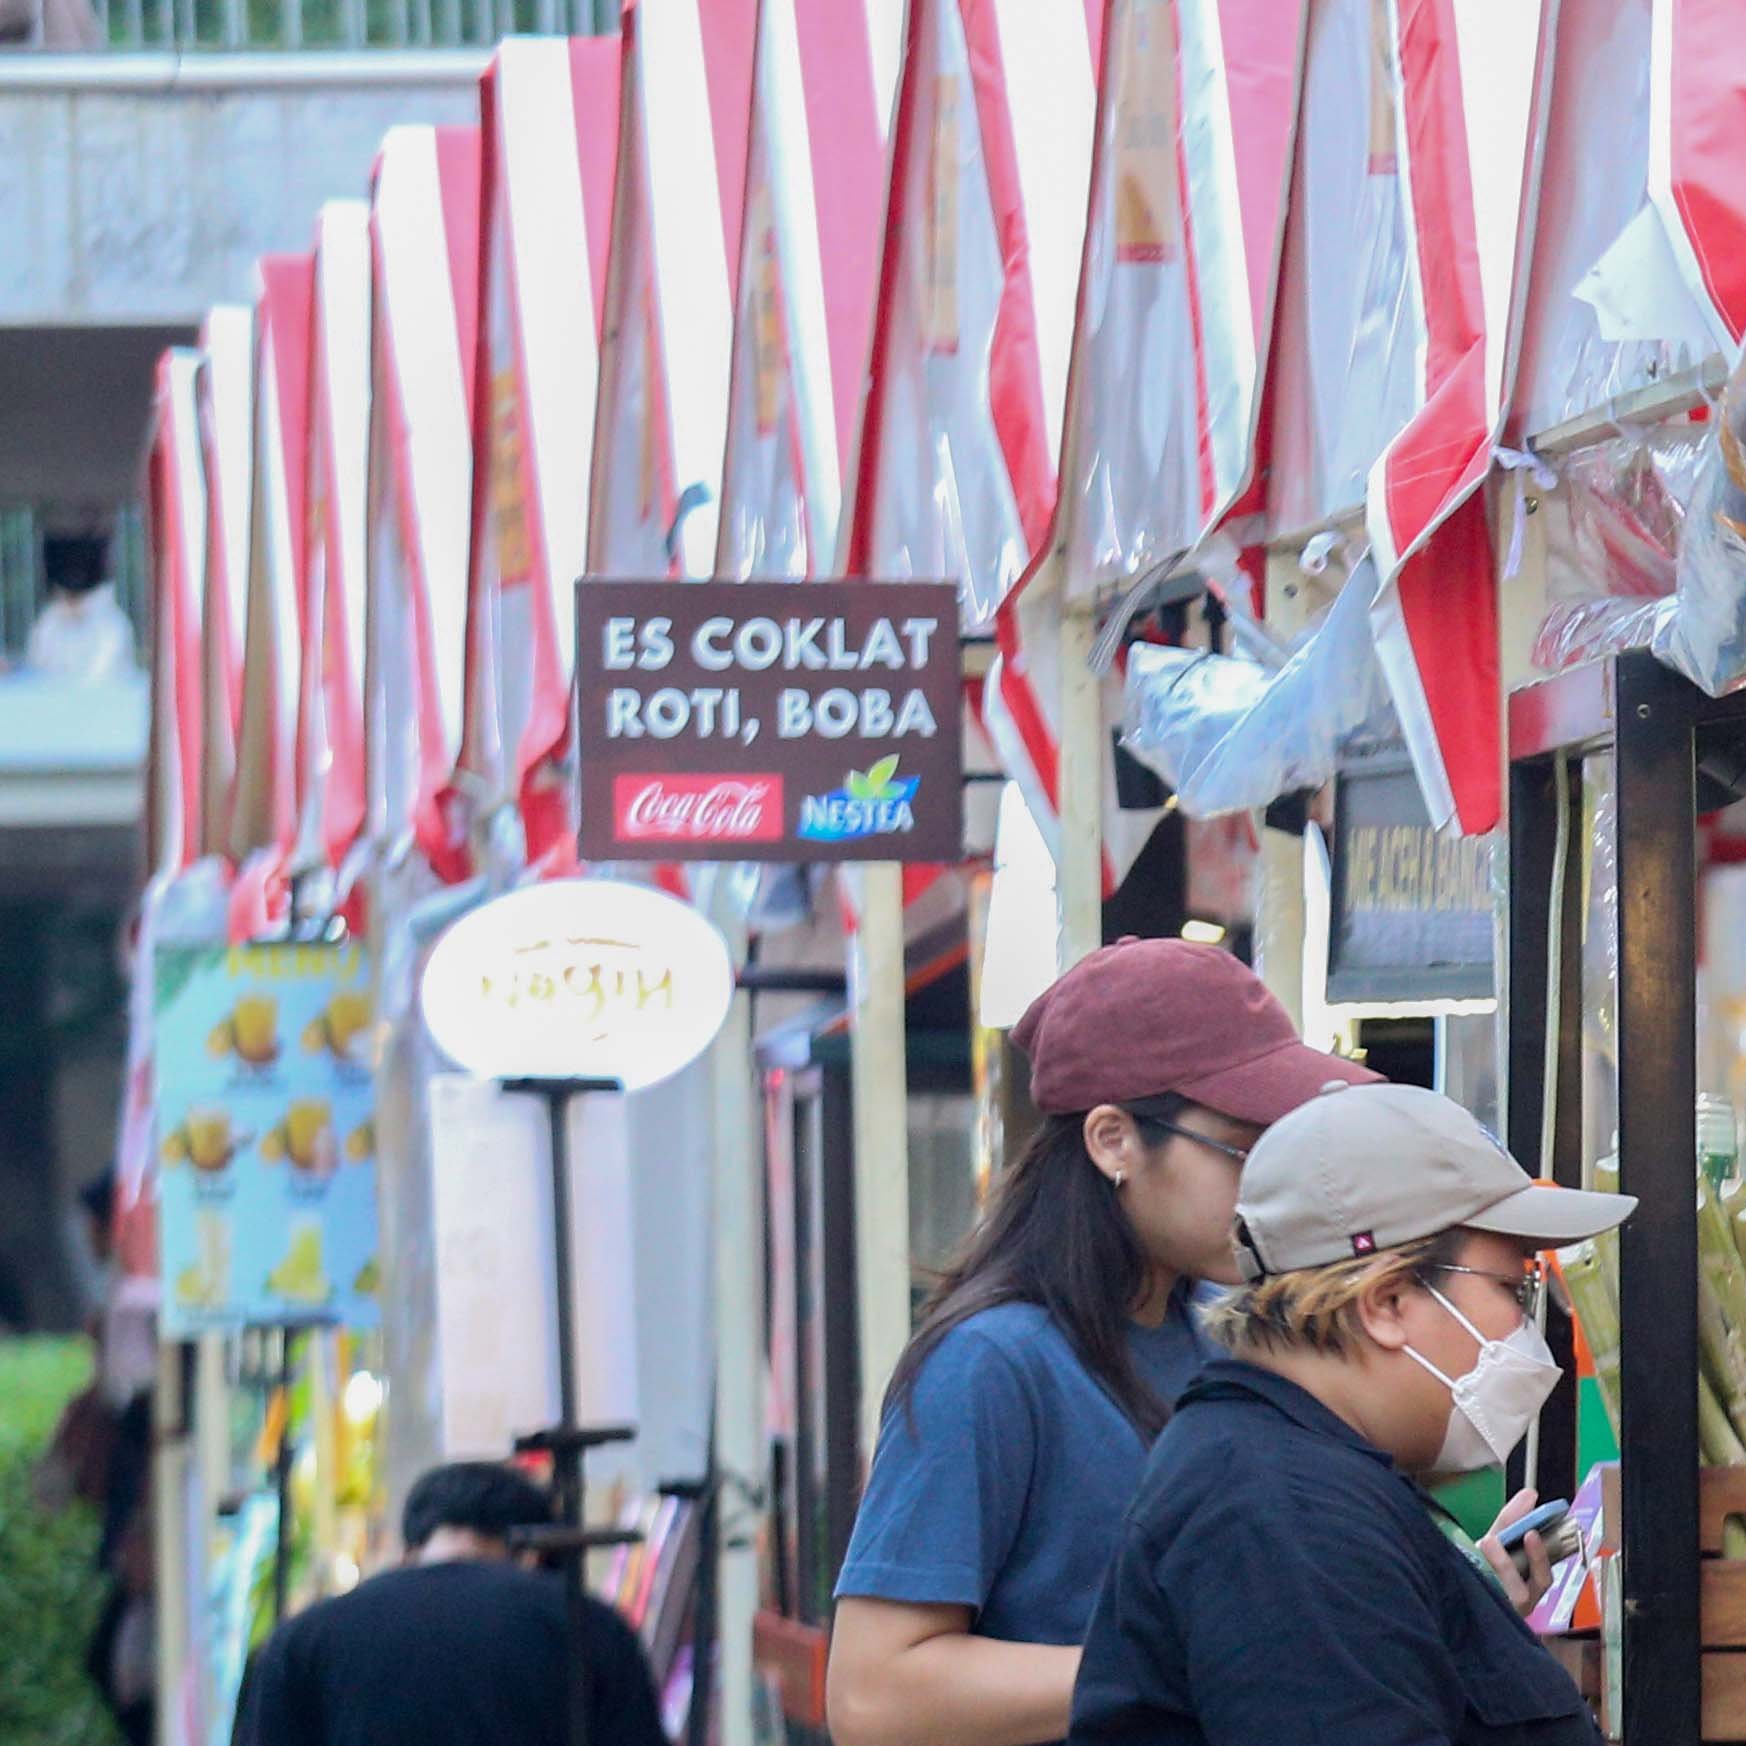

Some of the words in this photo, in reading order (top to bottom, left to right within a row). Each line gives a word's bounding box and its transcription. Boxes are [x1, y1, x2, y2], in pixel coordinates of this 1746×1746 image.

[603, 616, 675, 671] ES
[691, 616, 938, 671] COKLAT
[607, 687, 760, 746] ROTI,
[777, 687, 937, 739] BOBA
